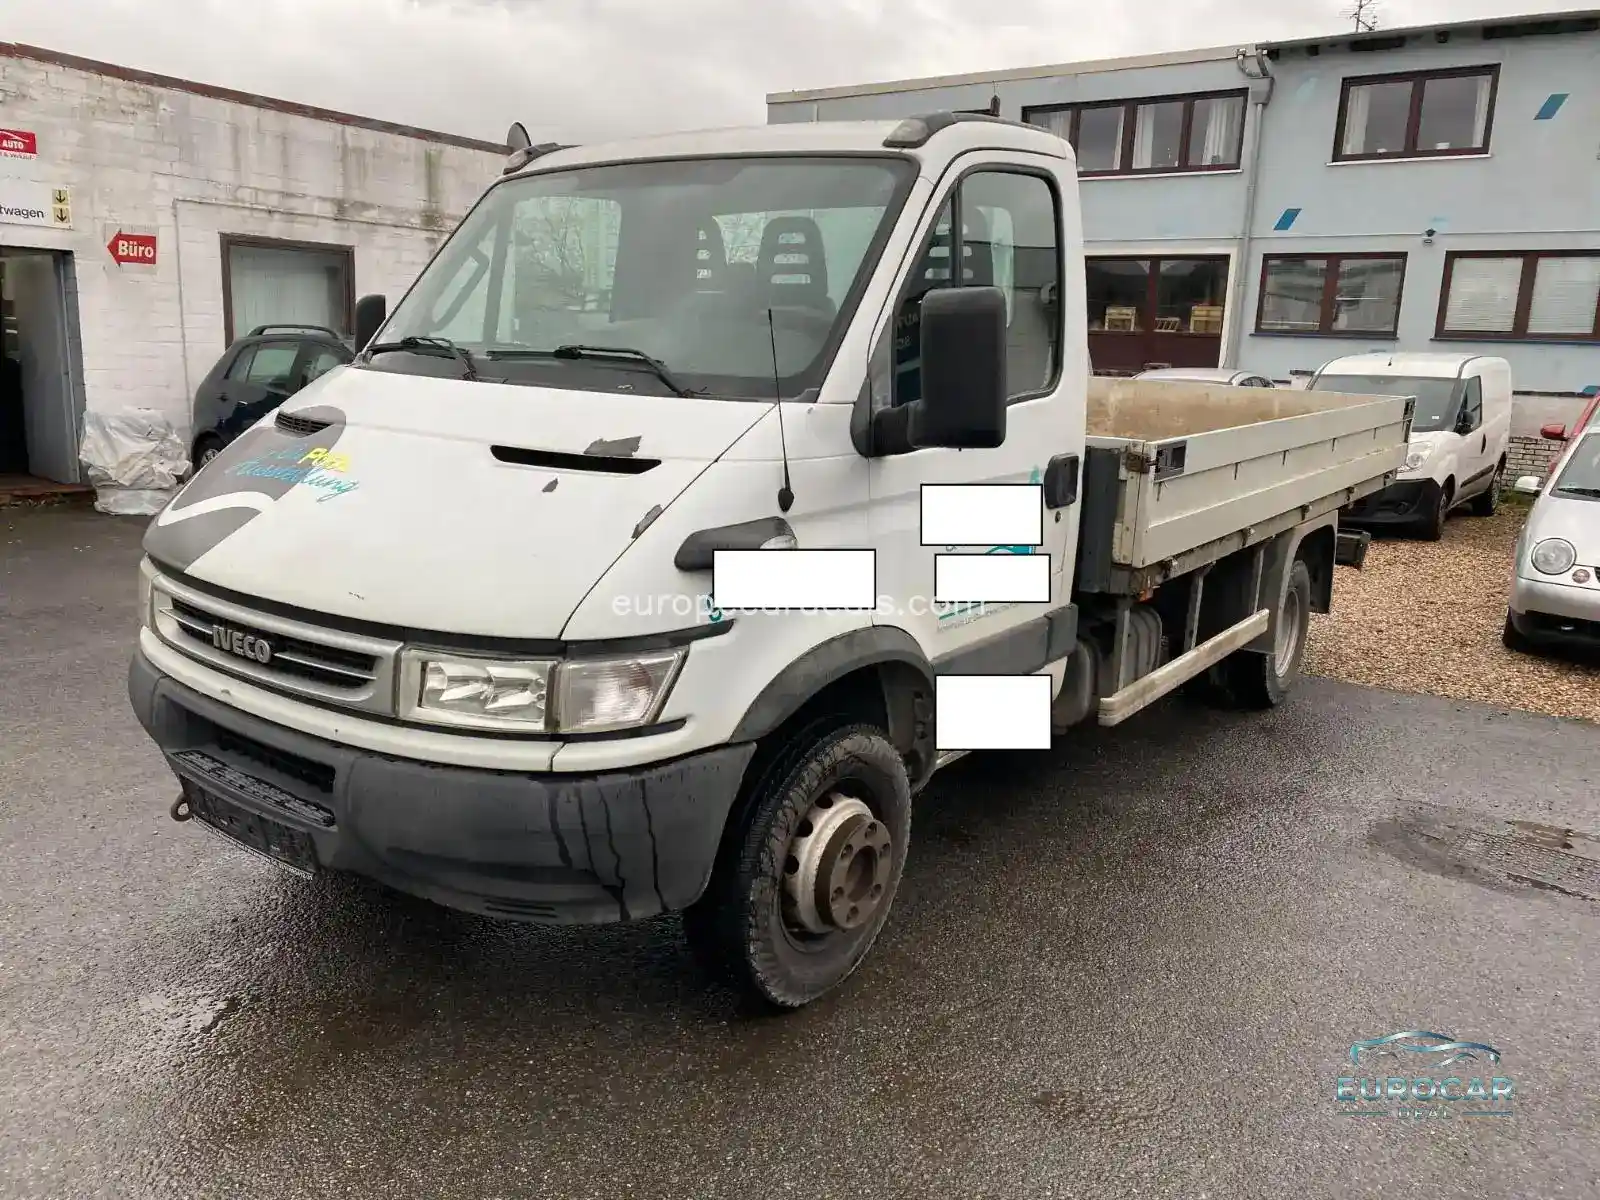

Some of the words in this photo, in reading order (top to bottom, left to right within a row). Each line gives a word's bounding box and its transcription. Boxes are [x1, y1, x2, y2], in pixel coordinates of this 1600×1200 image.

[2, 140, 24, 149] AUTO
[118, 239, 154, 258] Büro
[212, 624, 271, 664] IVECO
